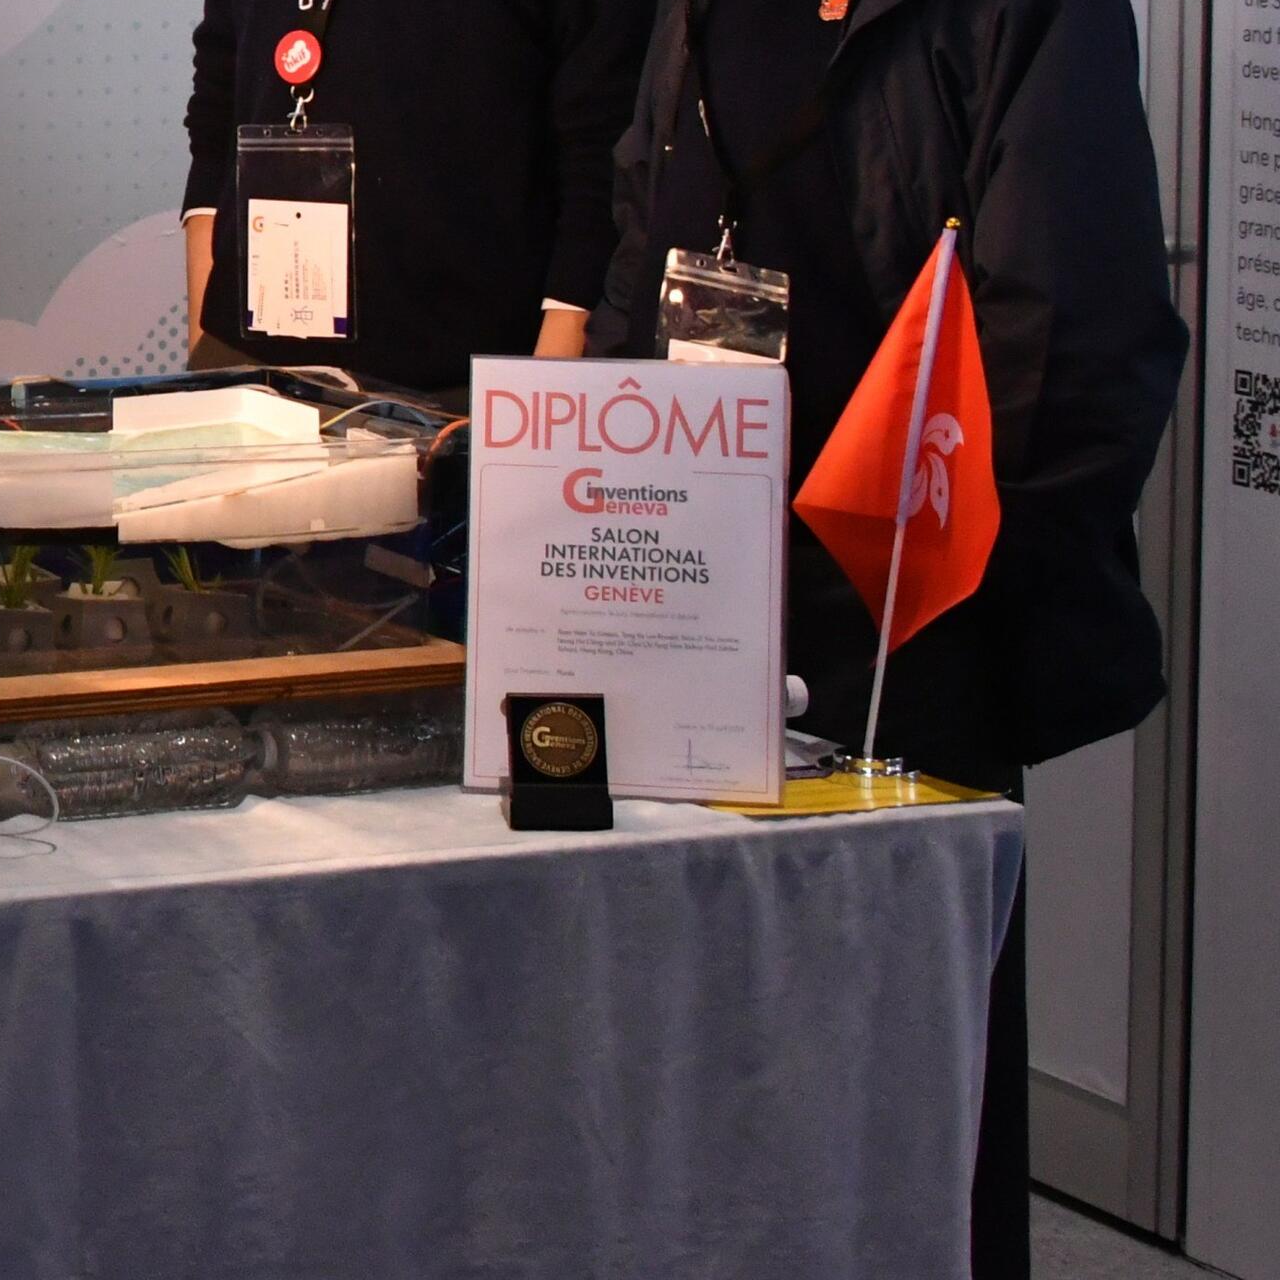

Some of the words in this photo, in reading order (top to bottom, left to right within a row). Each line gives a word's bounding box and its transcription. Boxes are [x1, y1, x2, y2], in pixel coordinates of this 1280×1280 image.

[1243, 28, 1272, 45] and
[1240, 150, 1269, 166] une
[485, 376, 769, 459] DIPLÔME
[563, 467, 668, 516] Geneva
[587, 482, 688, 502] inventions
[592, 527, 659, 544] SALON
[545, 544, 706, 565] INTERNATIONAL
[541, 562, 576, 578] DES
[583, 564, 709, 584] INVENTIONS
[584, 583, 664, 604] GENÈVE
